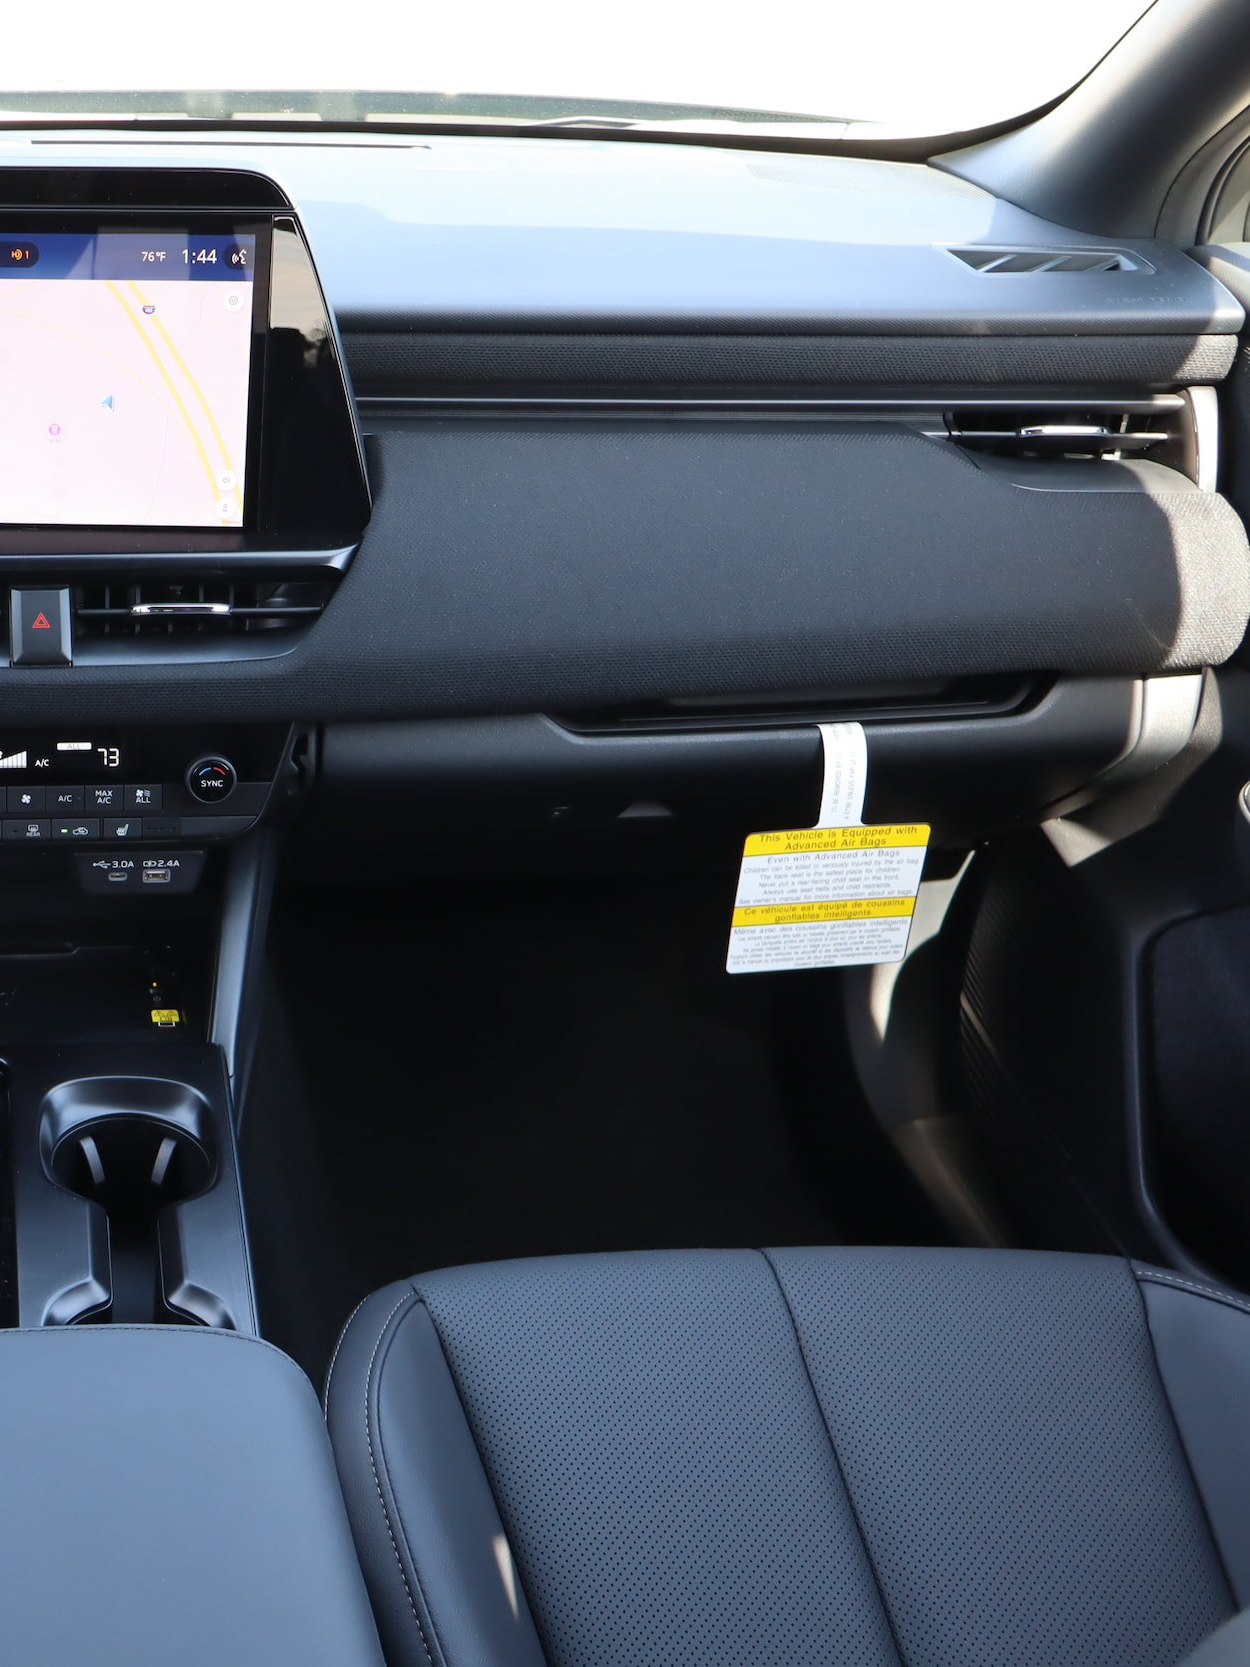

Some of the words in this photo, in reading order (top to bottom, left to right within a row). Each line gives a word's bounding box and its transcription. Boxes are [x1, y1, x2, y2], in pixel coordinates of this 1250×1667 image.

[182, 249, 218, 264] 1:44
[34, 759, 50, 768] A/C
[97, 748, 120, 767] 73
[201, 780, 224, 788] SYNC
[759, 834, 781, 843] This
[786, 830, 824, 841] Vehicle
[841, 827, 892, 838] Equipped
[896, 826, 917, 835] with
[784, 840, 836, 851] Advanced
[841, 839, 855, 847] Air
[860, 838, 887, 848] Bags
[767, 856, 789, 864] Even
[814, 852, 858, 861] Advanced
[862, 850, 874, 858] Air
[878, 849, 900, 858] Bags
[744, 908, 757, 916] Ce
[761, 905, 797, 915] véhicule
[801, 904, 814, 912] est
[818, 902, 848, 911] équipé
[851, 901, 863, 909] de
[866, 899, 905, 908] coussins
[775, 912, 820, 924] gonflables
[824, 910, 871, 920] intelligents
